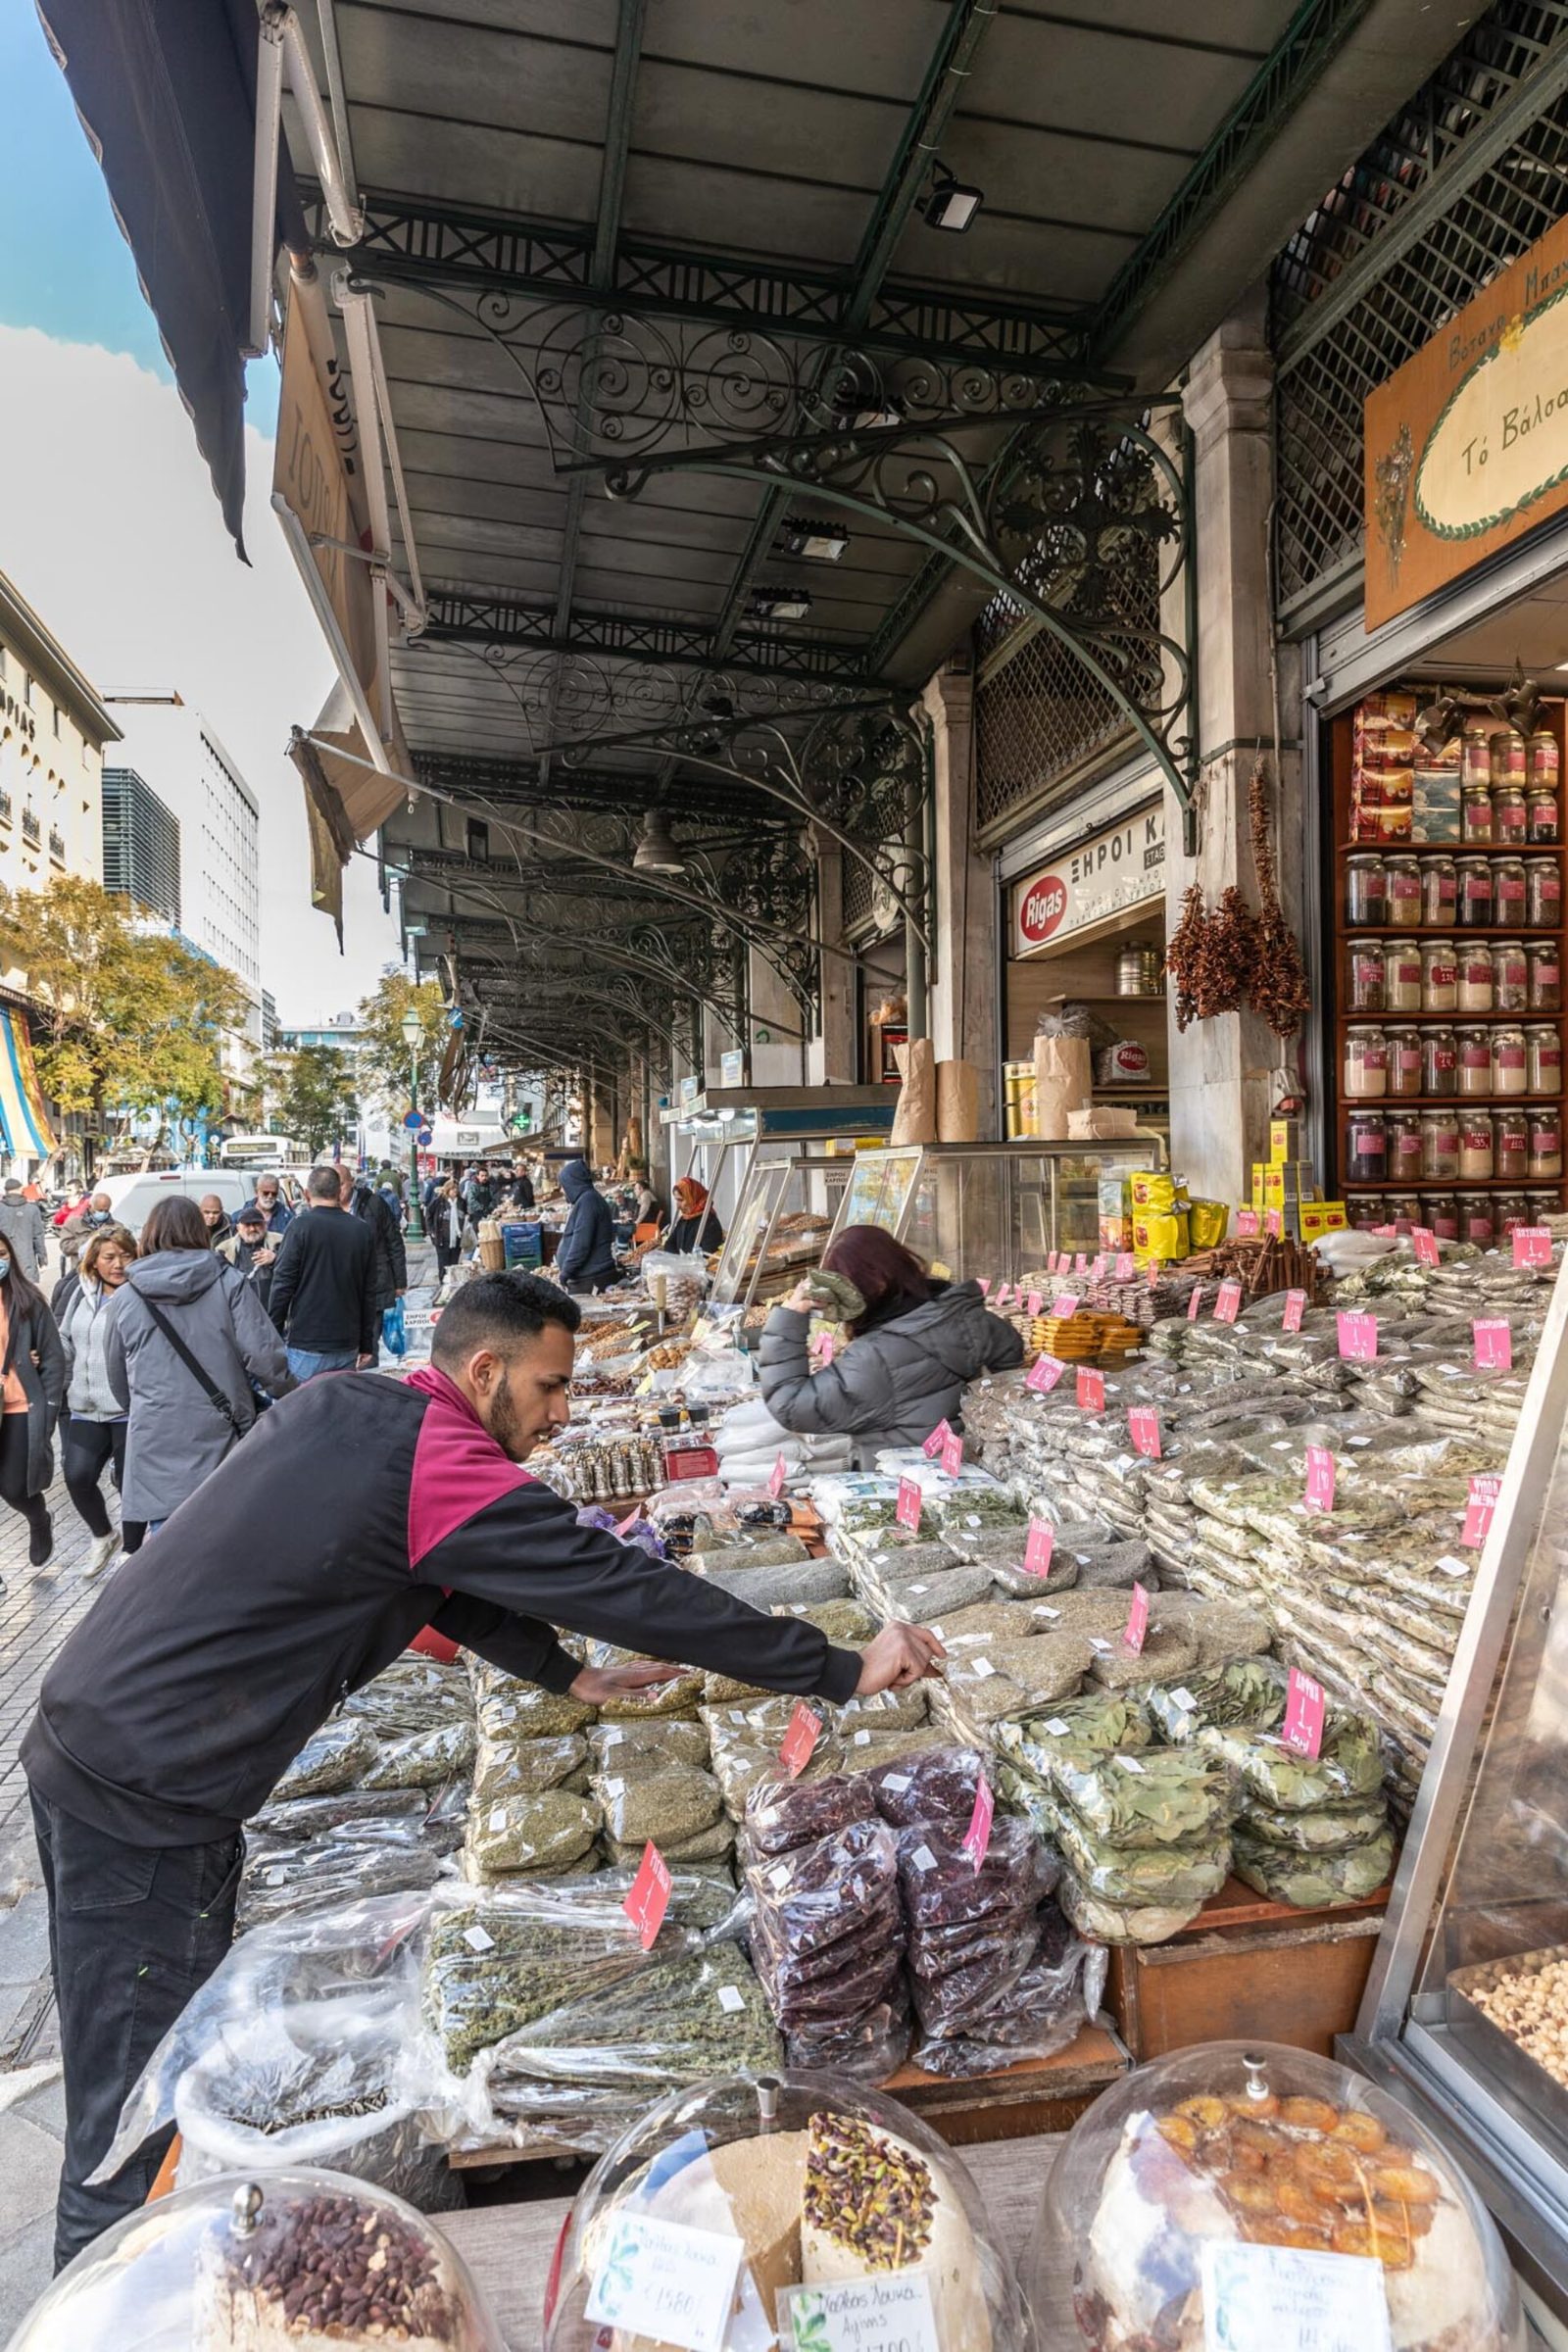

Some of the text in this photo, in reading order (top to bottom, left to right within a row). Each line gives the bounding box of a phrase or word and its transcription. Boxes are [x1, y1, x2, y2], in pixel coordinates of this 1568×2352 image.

[1461, 436, 1488, 475] Τό
[1071, 829, 1132, 884] ΞΗΡΟΙ
[1025, 888, 1063, 930] Rigas
